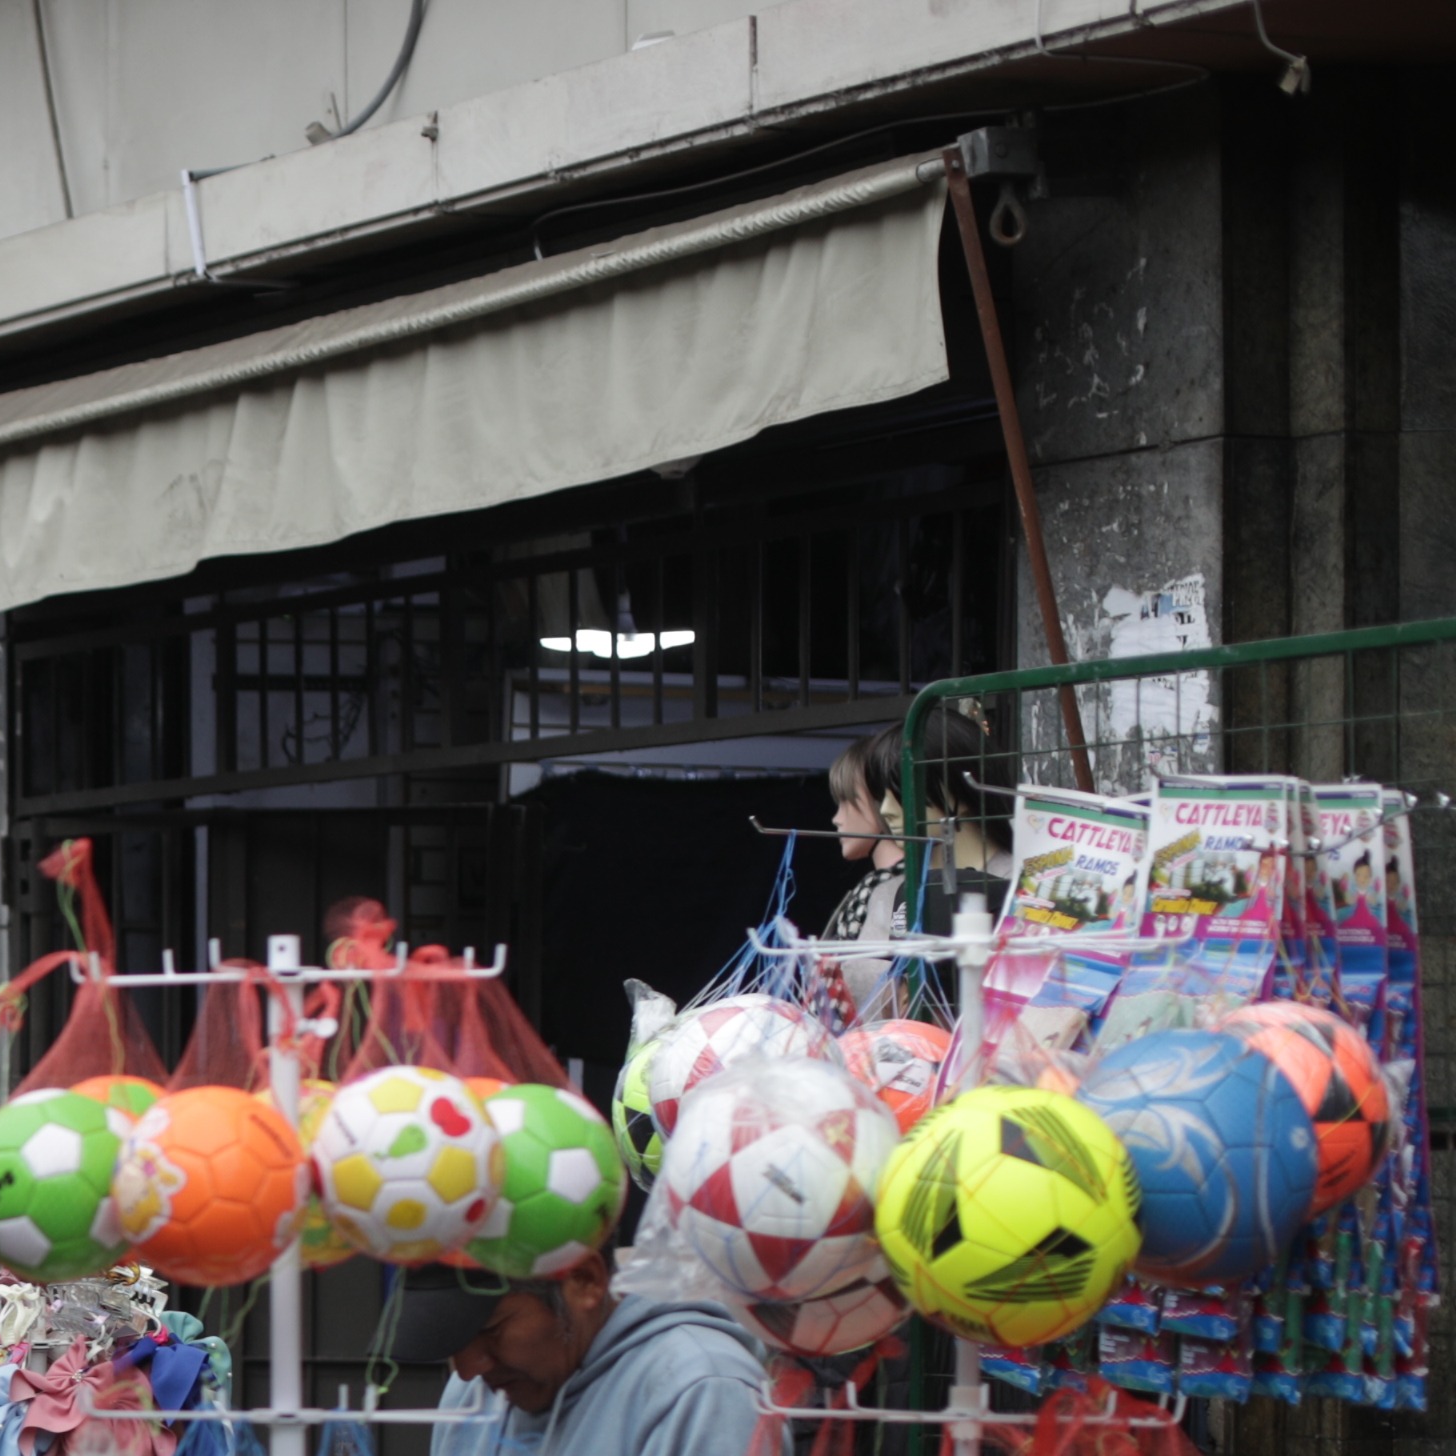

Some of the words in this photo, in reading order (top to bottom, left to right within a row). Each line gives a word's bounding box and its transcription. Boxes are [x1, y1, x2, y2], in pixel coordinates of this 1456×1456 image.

[1174, 803, 1263, 827] CATTLEYA
[1047, 816, 1133, 854] CATTLEYA
[1204, 835, 1254, 851] RAMO
[1075, 854, 1120, 877] RAMOS
